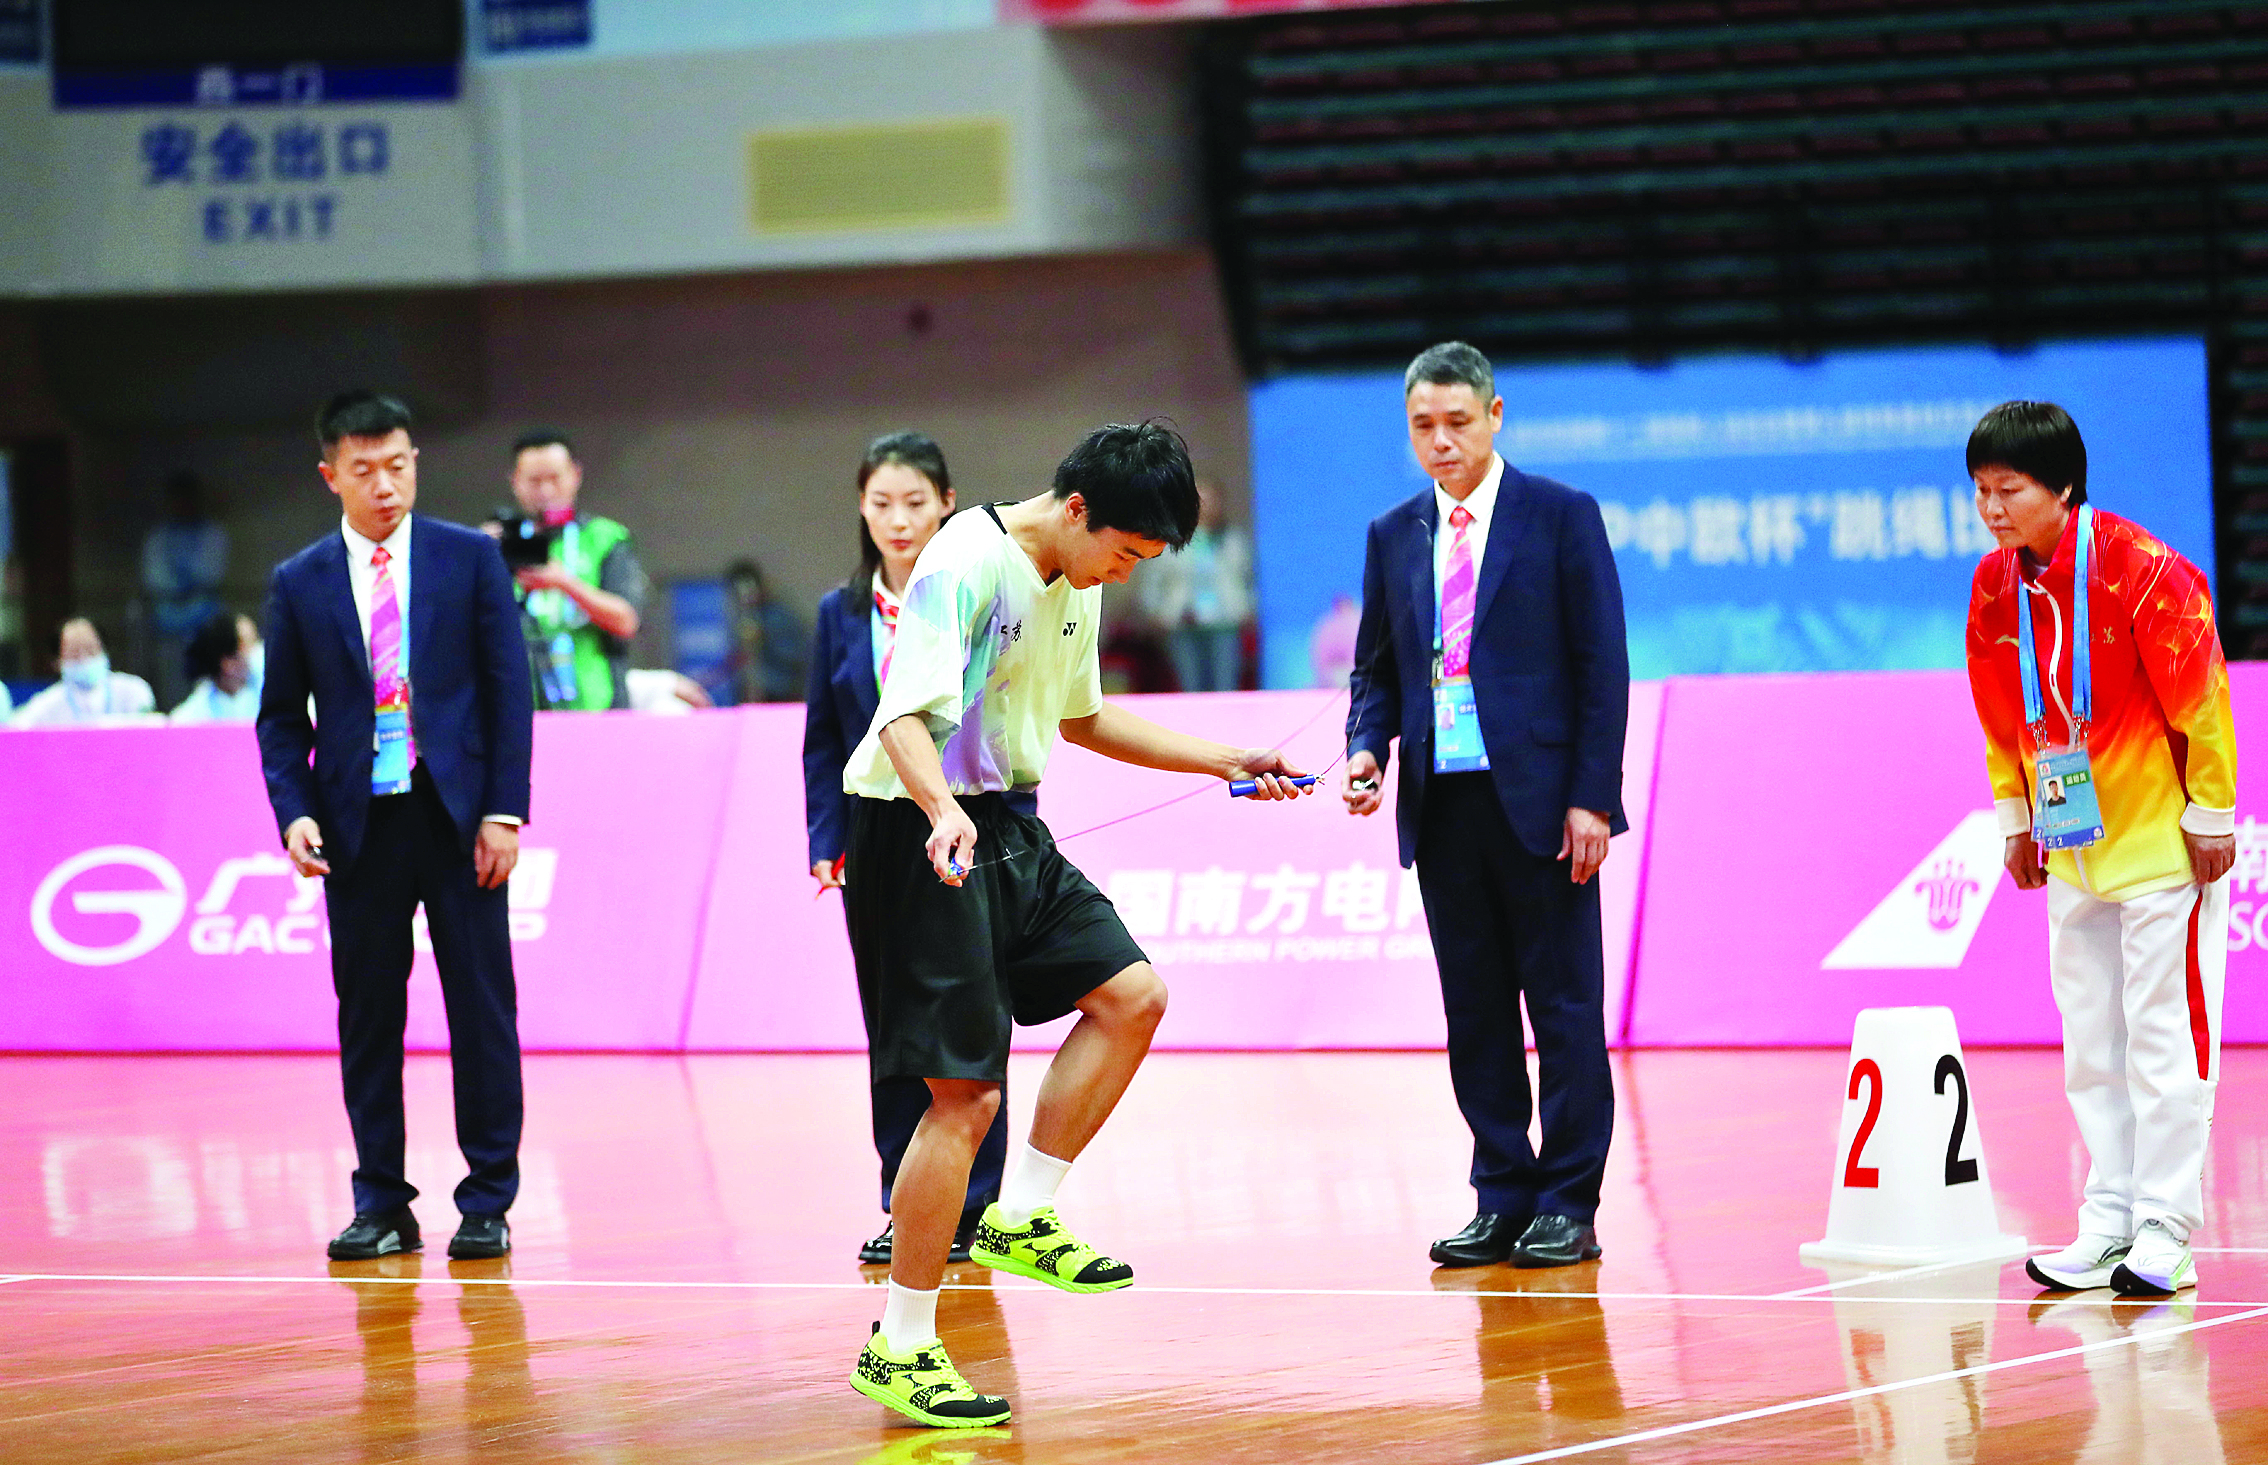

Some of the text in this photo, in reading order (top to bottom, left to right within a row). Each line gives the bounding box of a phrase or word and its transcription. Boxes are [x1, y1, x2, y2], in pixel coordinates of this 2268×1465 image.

[140, 121, 392, 187] 安全出口
[201, 194, 338, 243] EXIT
[1105, 861, 1424, 936] 国南方电
[189, 913, 319, 955] GAC
[1844, 1053, 1979, 1189] 2 2
